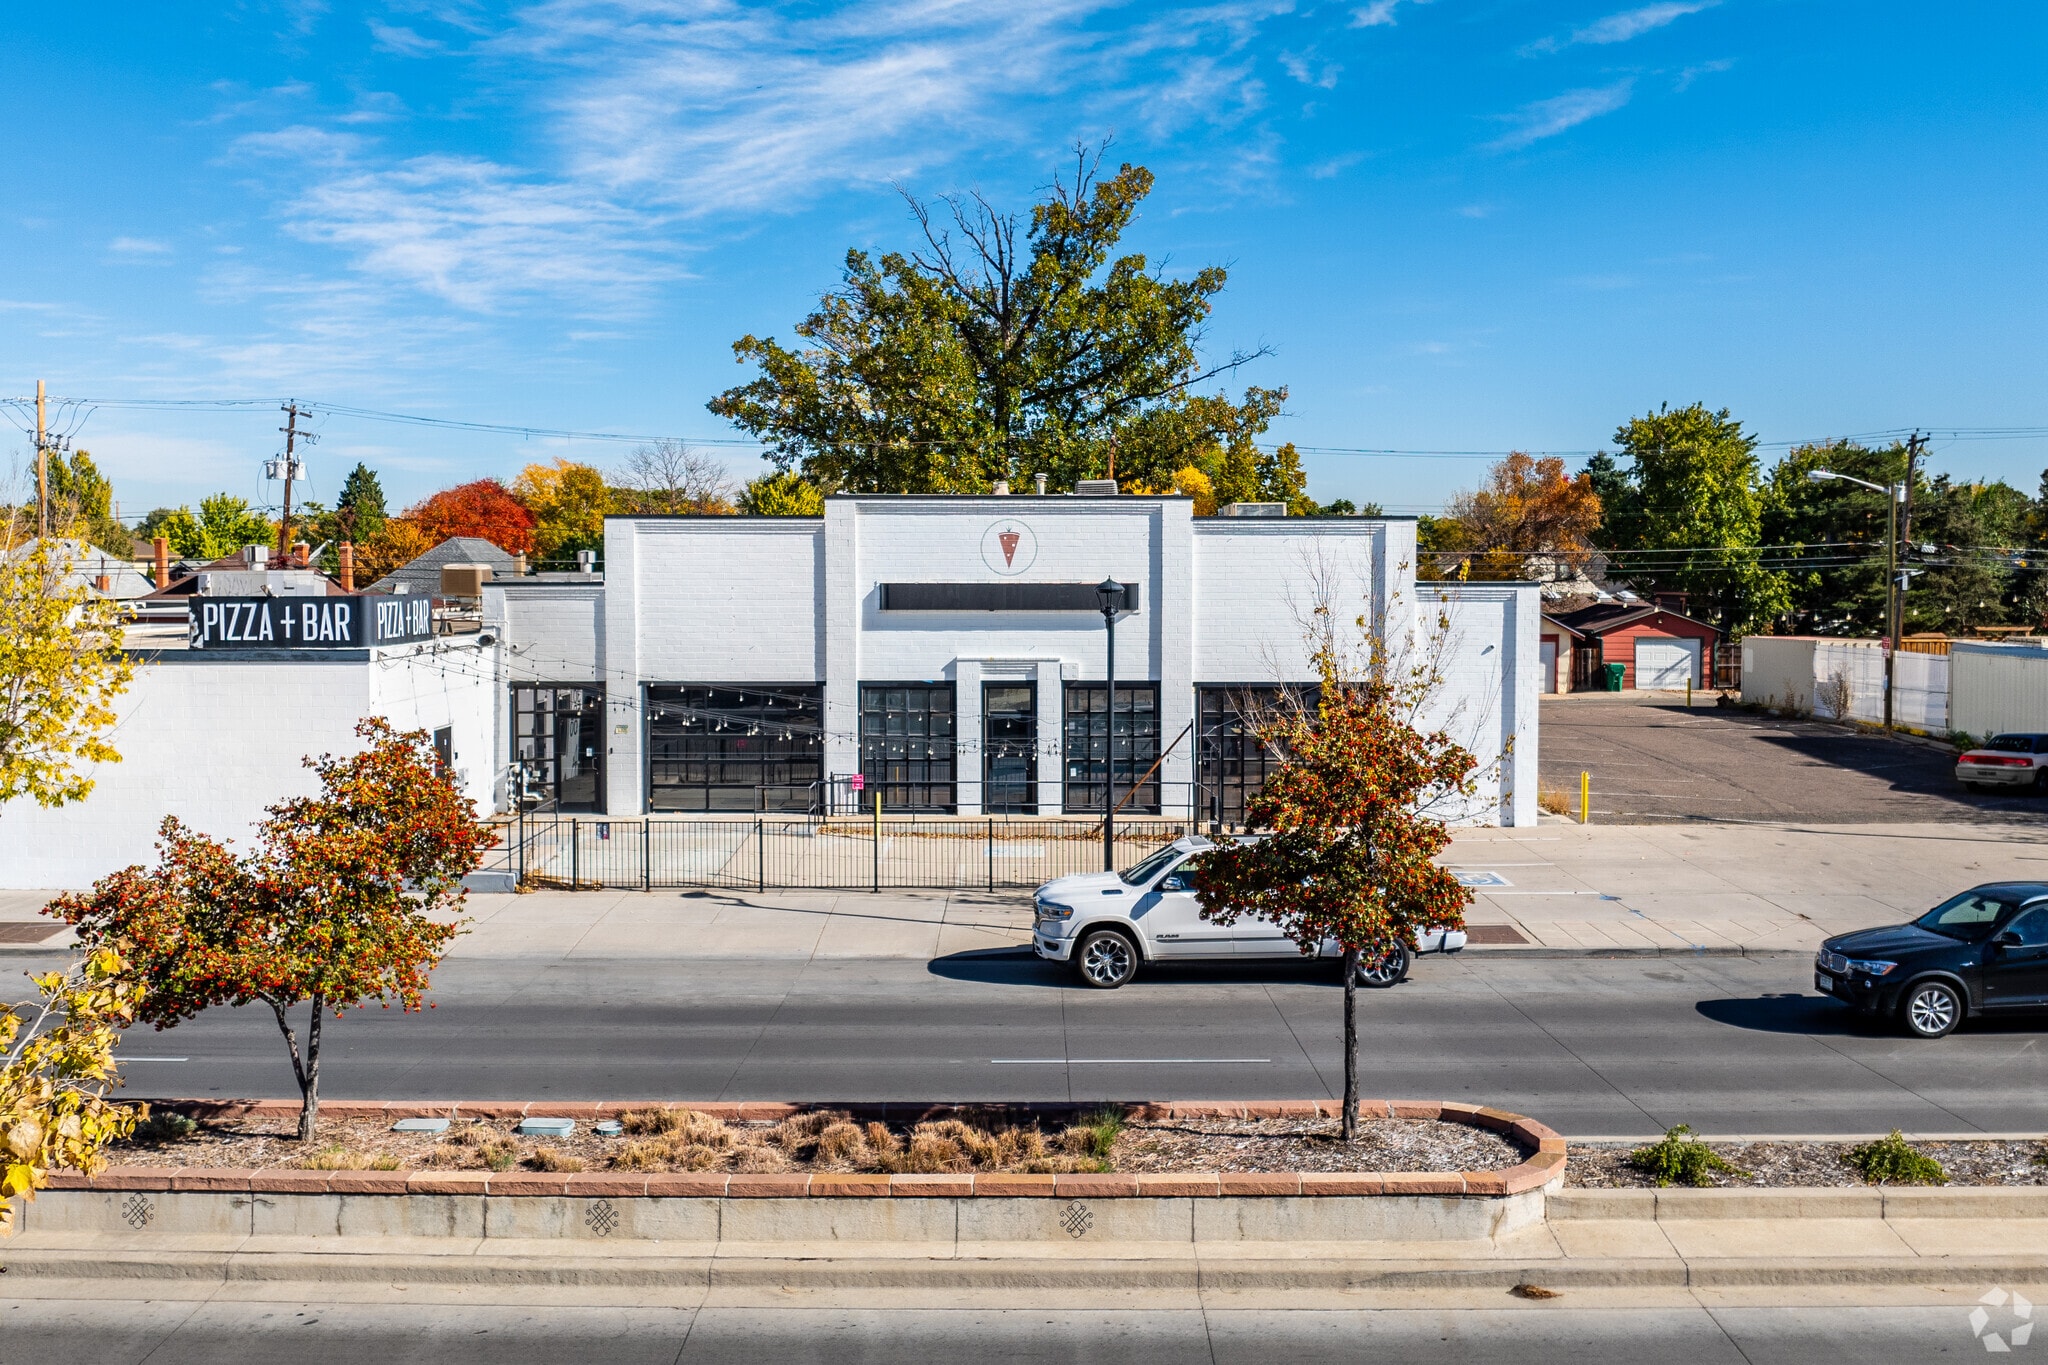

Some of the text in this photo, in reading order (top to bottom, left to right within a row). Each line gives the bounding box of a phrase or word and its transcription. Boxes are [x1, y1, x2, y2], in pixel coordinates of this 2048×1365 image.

[203, 603, 351, 641] PIZZA + BAR
[377, 599, 430, 640] PIZZA + BAR
